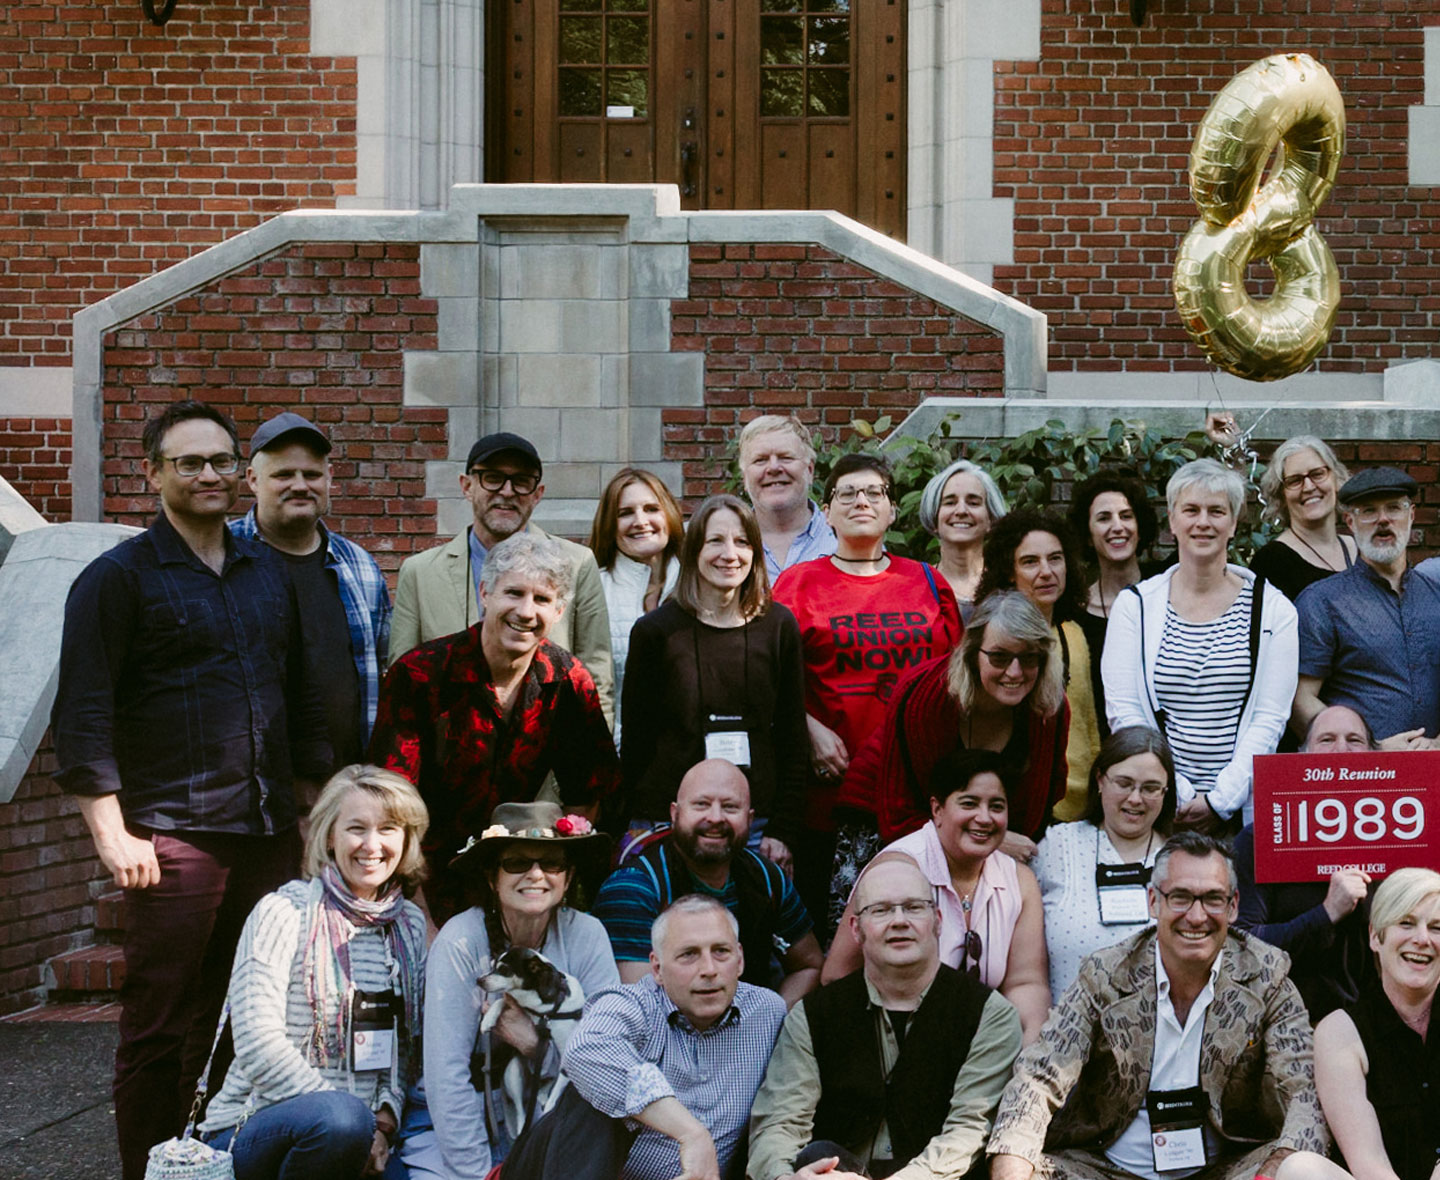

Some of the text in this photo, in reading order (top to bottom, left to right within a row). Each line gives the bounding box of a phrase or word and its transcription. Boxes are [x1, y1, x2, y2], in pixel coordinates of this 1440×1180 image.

[1173, 54, 1345, 382] 8
[829, 612, 928, 630] REED
[833, 627, 933, 648] UNION
[1303, 767, 1396, 782] 30th Reunion
[1272, 802, 1283, 844] CLASS OF
[1298, 796, 1425, 843] 1989
[1317, 864, 1342, 875] REED
